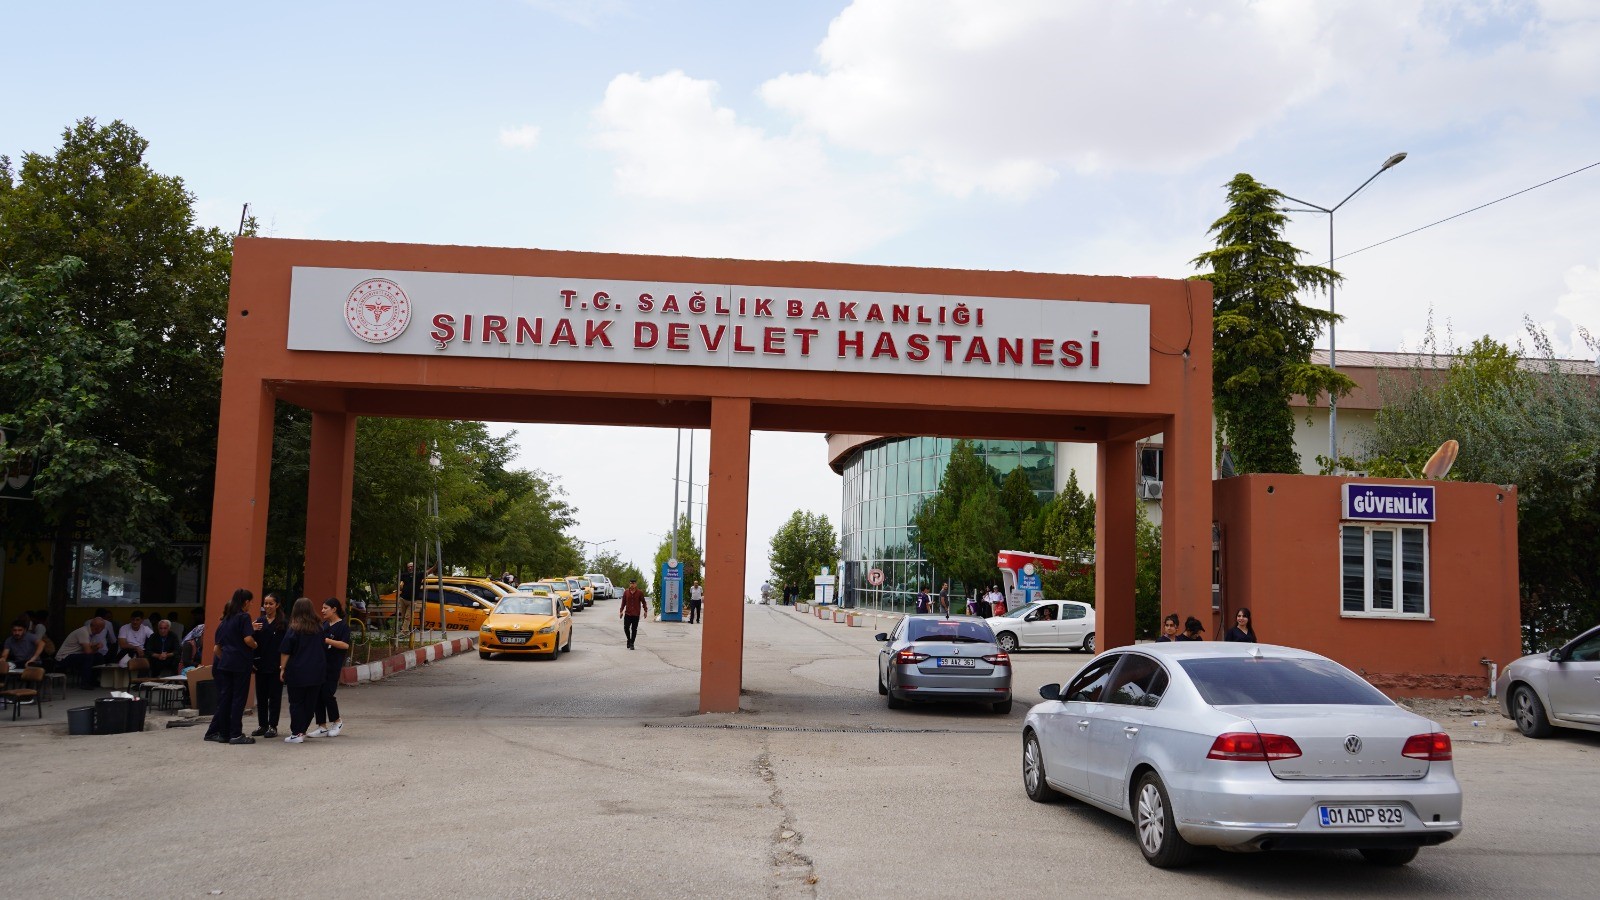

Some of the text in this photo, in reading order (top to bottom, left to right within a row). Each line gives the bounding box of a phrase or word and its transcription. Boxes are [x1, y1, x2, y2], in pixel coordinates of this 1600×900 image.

[560, 289, 986, 327] T.C. SAĞLIK BAKANLIĞI
[431, 312, 1101, 369] ŞIRNAK DEVLET HASTANESİ
[1353, 491, 1429, 514] GÜVENLİK
[1328, 808, 1344, 824] 01
[1347, 808, 1375, 824] ADP
[1377, 808, 1403, 823] 829
